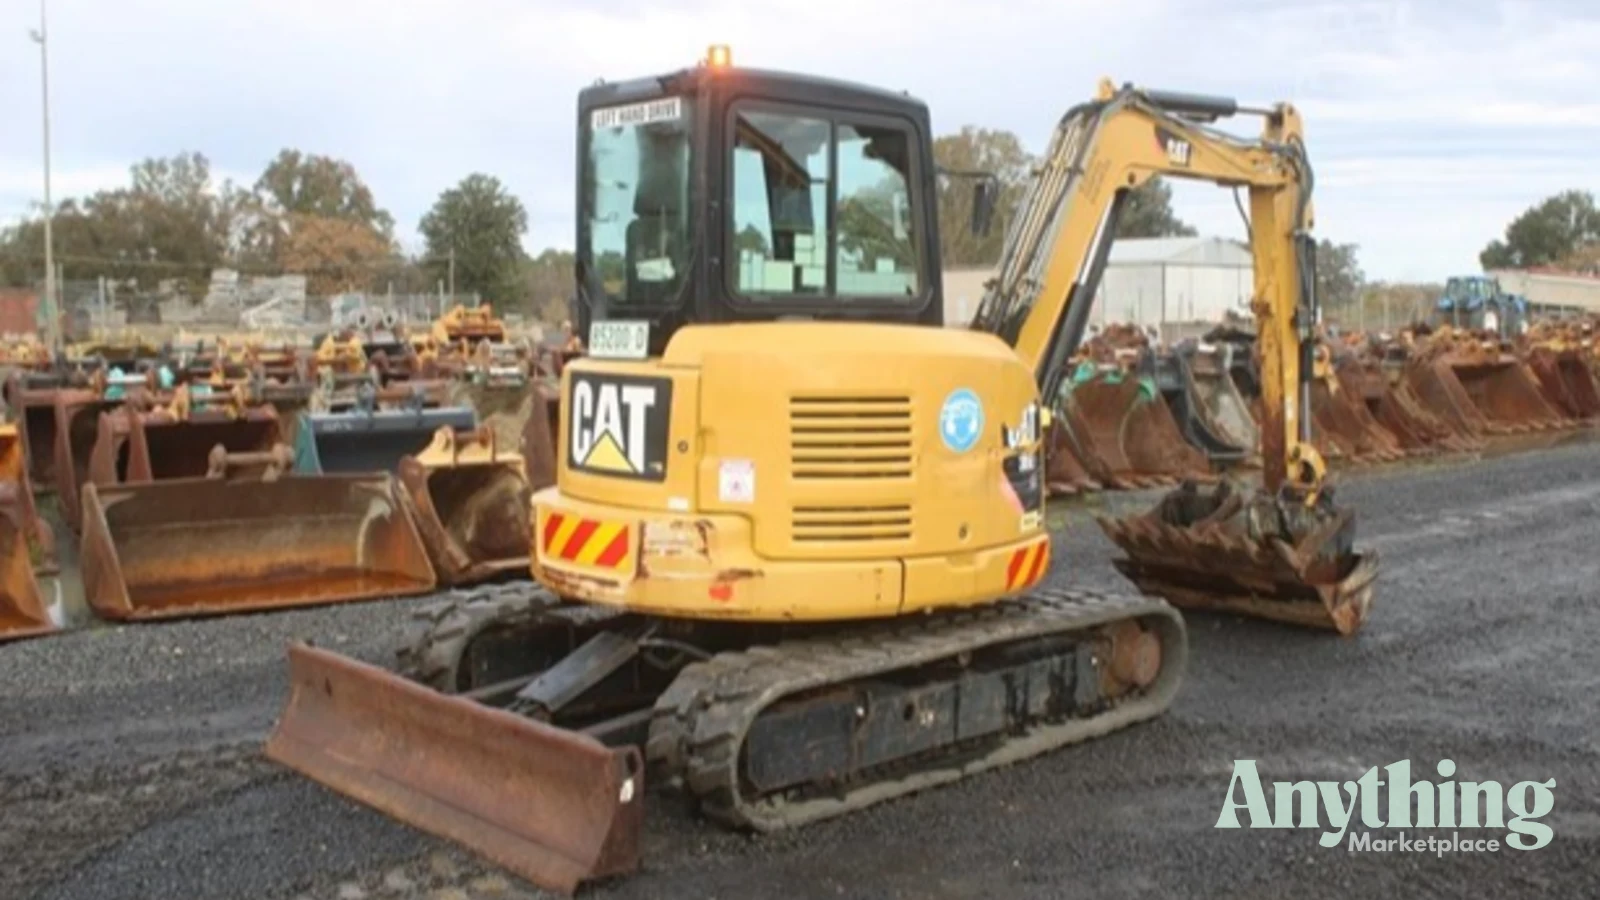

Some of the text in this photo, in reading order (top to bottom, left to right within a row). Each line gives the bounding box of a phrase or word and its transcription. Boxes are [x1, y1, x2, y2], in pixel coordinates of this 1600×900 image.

[619, 104, 644, 121] HAND
[649, 100, 676, 118] DRIVE
[572, 379, 655, 474] CAT
